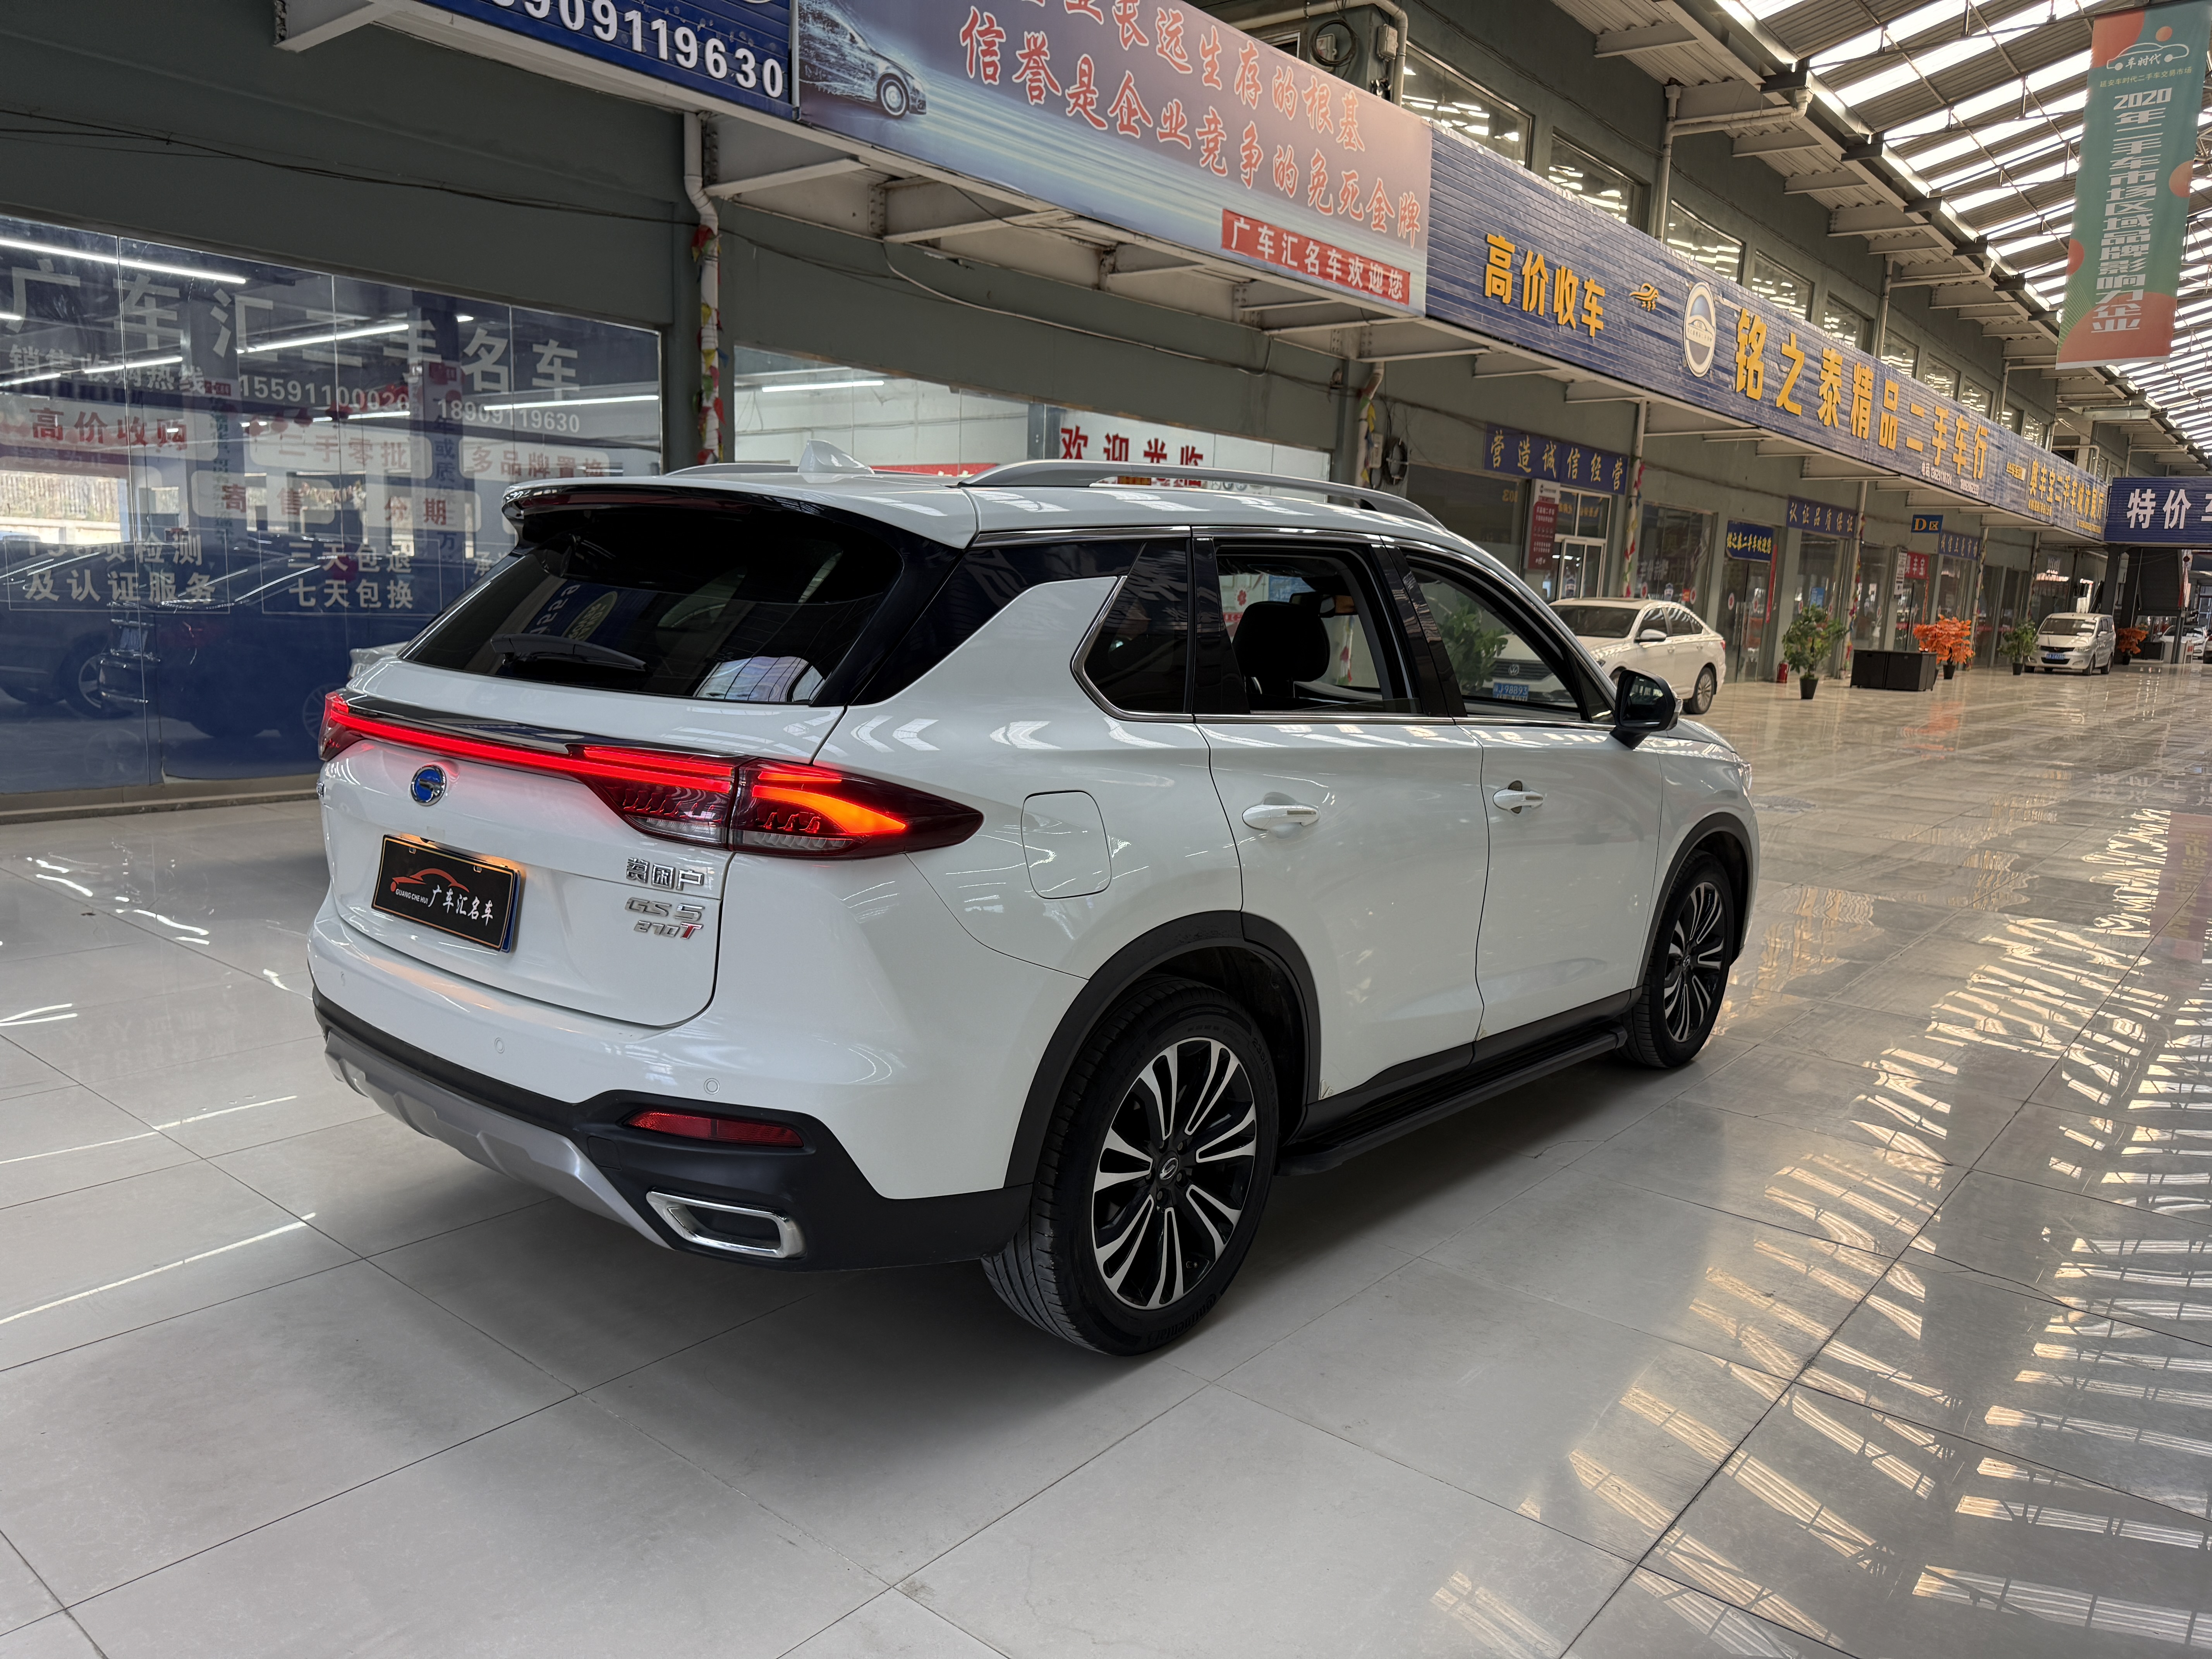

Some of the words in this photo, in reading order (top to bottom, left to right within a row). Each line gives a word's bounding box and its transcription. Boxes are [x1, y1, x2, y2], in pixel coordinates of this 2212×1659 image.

[2100, 66, 2193, 88] 延安车时代二手车交易市场
[2125, 53, 2162, 70] 车时代
[2113, 88, 2172, 110] 2020
[960, 5, 1421, 249] 信誉是企业竞争的免死金牌
[1231, 218, 1403, 301] 广车汇名车欢迎您
[1484, 233, 1606, 337] 高价收车
[5, 259, 581, 402] 广车汇二手名车
[1735, 308, 1989, 480] 铭之泰精品二手车行
[29, 407, 187, 451] 高价收购
[1491, 429, 1623, 491] 营造诚信经营
[23, 568, 216, 604] 及认证服务
[288, 578, 413, 610] 七天包换
[396, 888, 411, 899] GUANG
[411, 894, 420, 902] CHE
[428, 884, 493, 926] 广车汇名车
[634, 920, 704, 939] 270T
